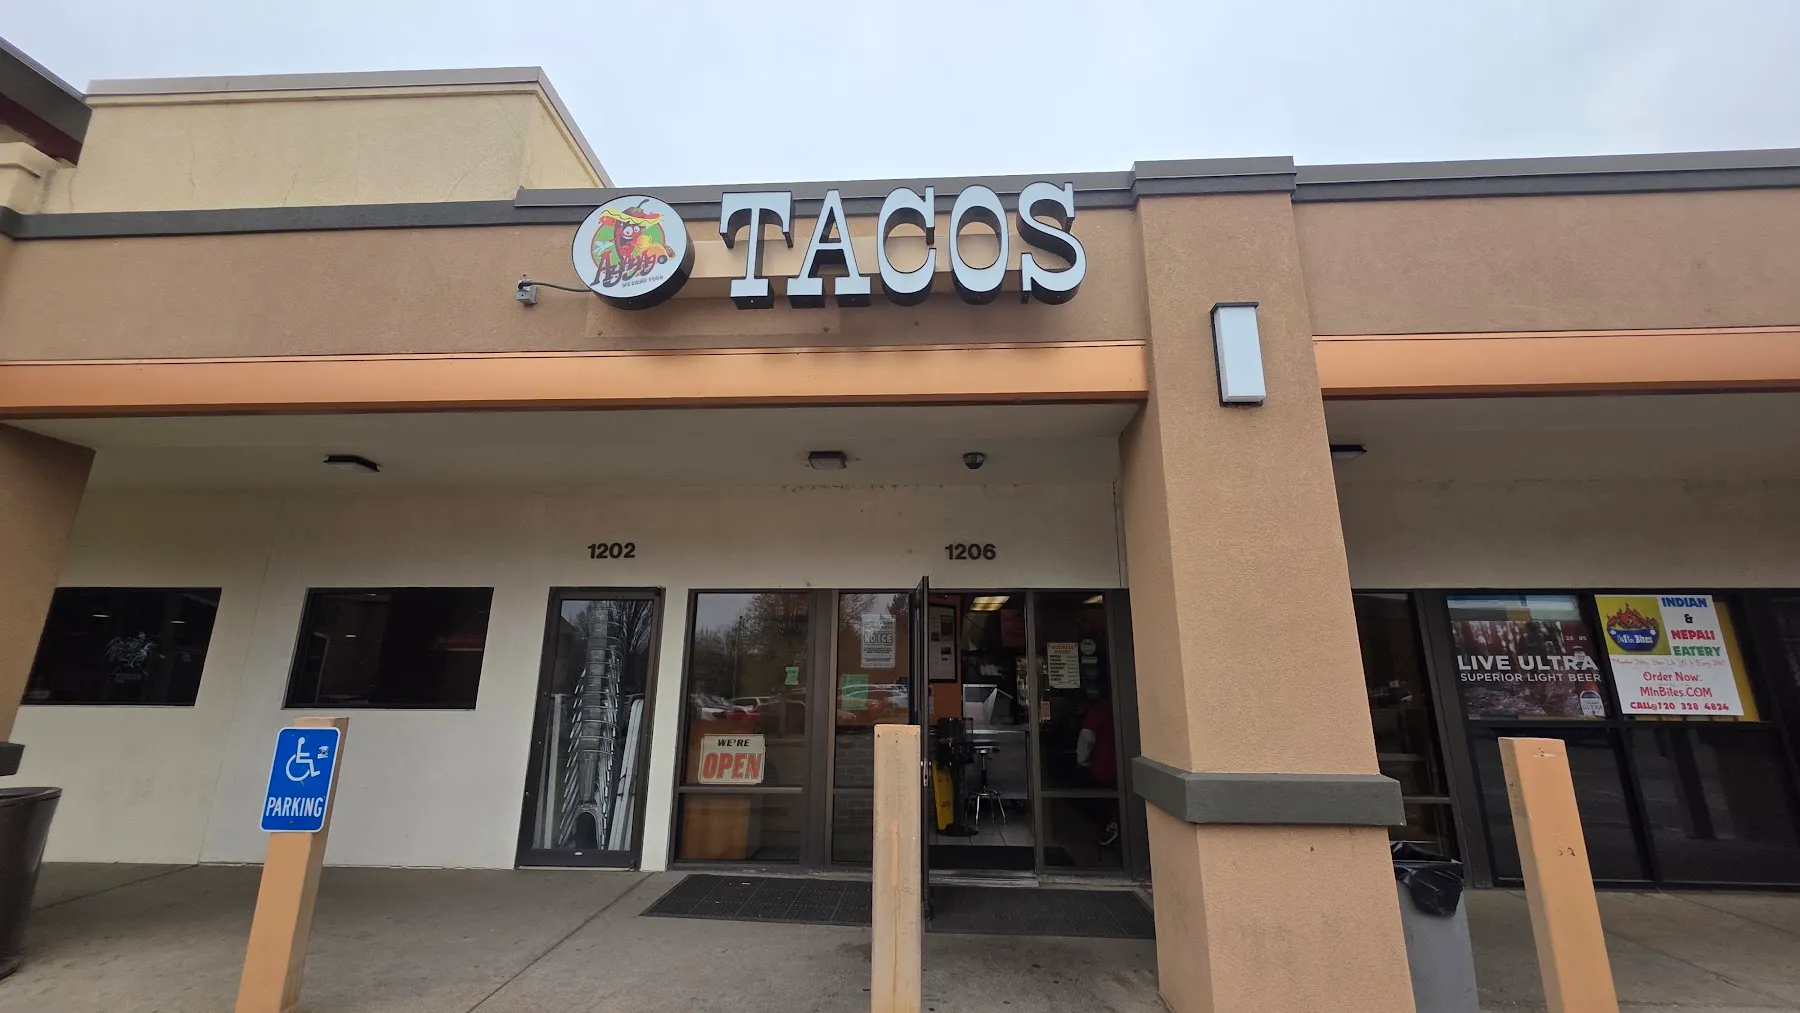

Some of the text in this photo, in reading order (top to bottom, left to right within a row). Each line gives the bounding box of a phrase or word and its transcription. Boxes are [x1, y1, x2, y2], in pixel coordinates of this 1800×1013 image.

[719, 182, 1087, 298] TACOS
[587, 542, 636, 559] 1202
[945, 543, 996, 560] 1206
[1661, 597, 1708, 608] INDIAN
[1684, 613, 1693, 623] &
[1634, 634, 1654, 644] Bites
[1670, 629, 1715, 640] NEPALI
[1672, 645, 1721, 657] EATERY
[1457, 655, 1511, 670] LIVE
[1517, 655, 1598, 671] ULTRA
[1460, 673, 1602, 682] SUPERIOR LIGHT BEER
[1643, 671, 1672, 681] Order
[1681, 702, 1699, 710] 328
[717, 739, 750, 747] WE'RE
[702, 752, 763, 780] OPEN
[265, 796, 324, 818] PARKING
